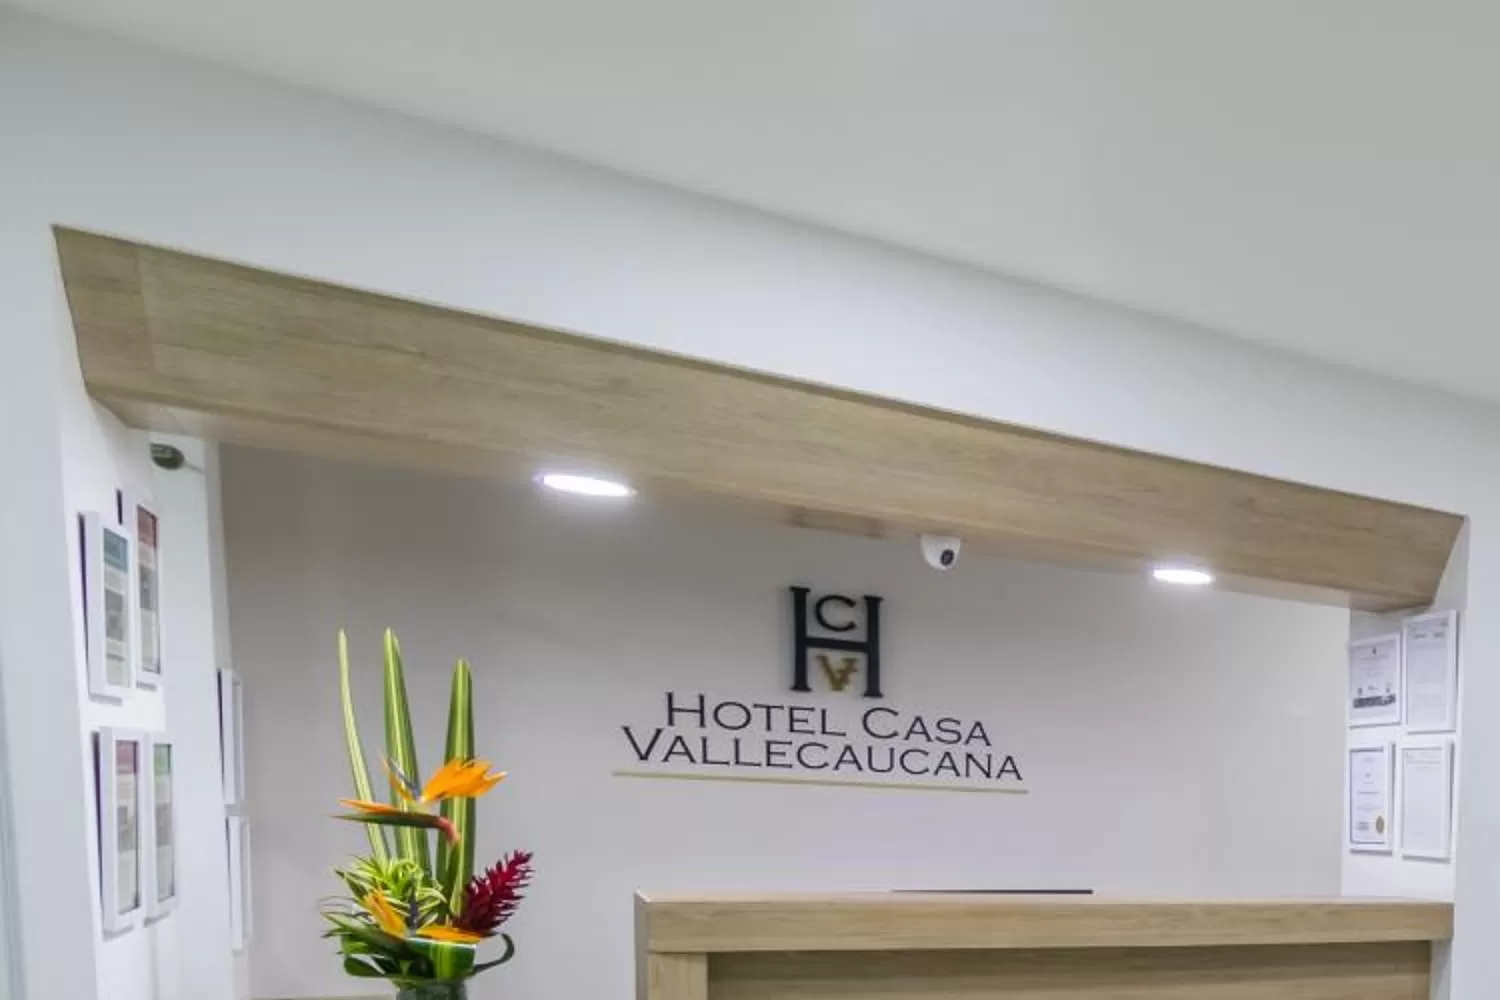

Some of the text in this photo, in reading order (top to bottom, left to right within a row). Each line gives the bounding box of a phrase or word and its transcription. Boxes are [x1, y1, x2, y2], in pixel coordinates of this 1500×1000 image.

[665, 691, 992, 746] HOTEL CASA
[621, 725, 1022, 780] VALLECAUCANA
